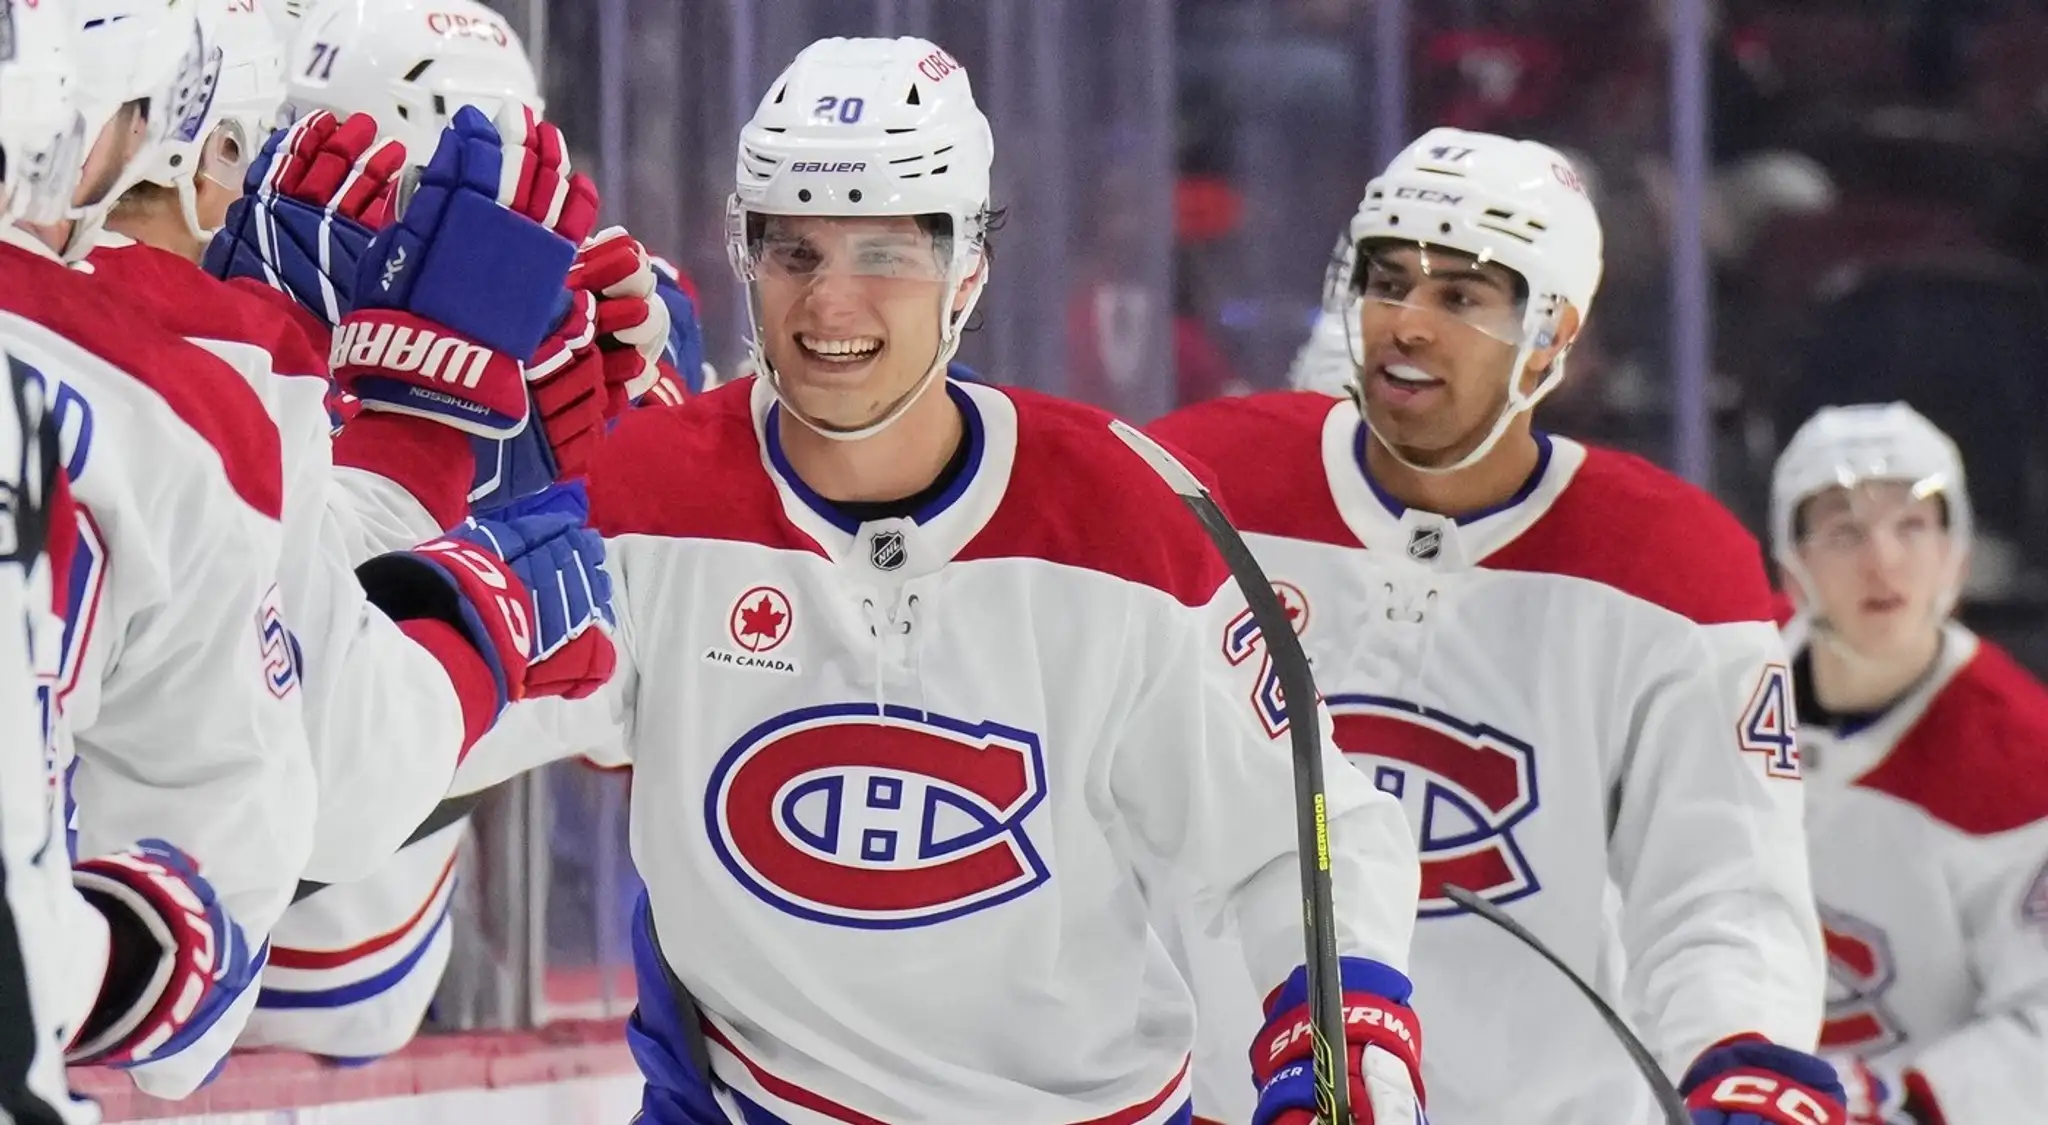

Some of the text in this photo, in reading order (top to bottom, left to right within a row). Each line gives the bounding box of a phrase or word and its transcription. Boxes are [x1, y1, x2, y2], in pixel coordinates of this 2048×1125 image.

[304, 42, 340, 81] 71
[813, 95, 864, 125] 20
[791, 161, 867, 173] BAUER
[1395, 187, 1463, 206] CCM
[328, 321, 494, 389] WARR
[408, 386, 491, 416] MATHESON
[706, 650, 795, 673] AIR CANADA
[1222, 606, 1295, 740] 2
[1313, 793, 1329, 872] SHERWOOD
[1711, 1075, 1829, 1125] CC
